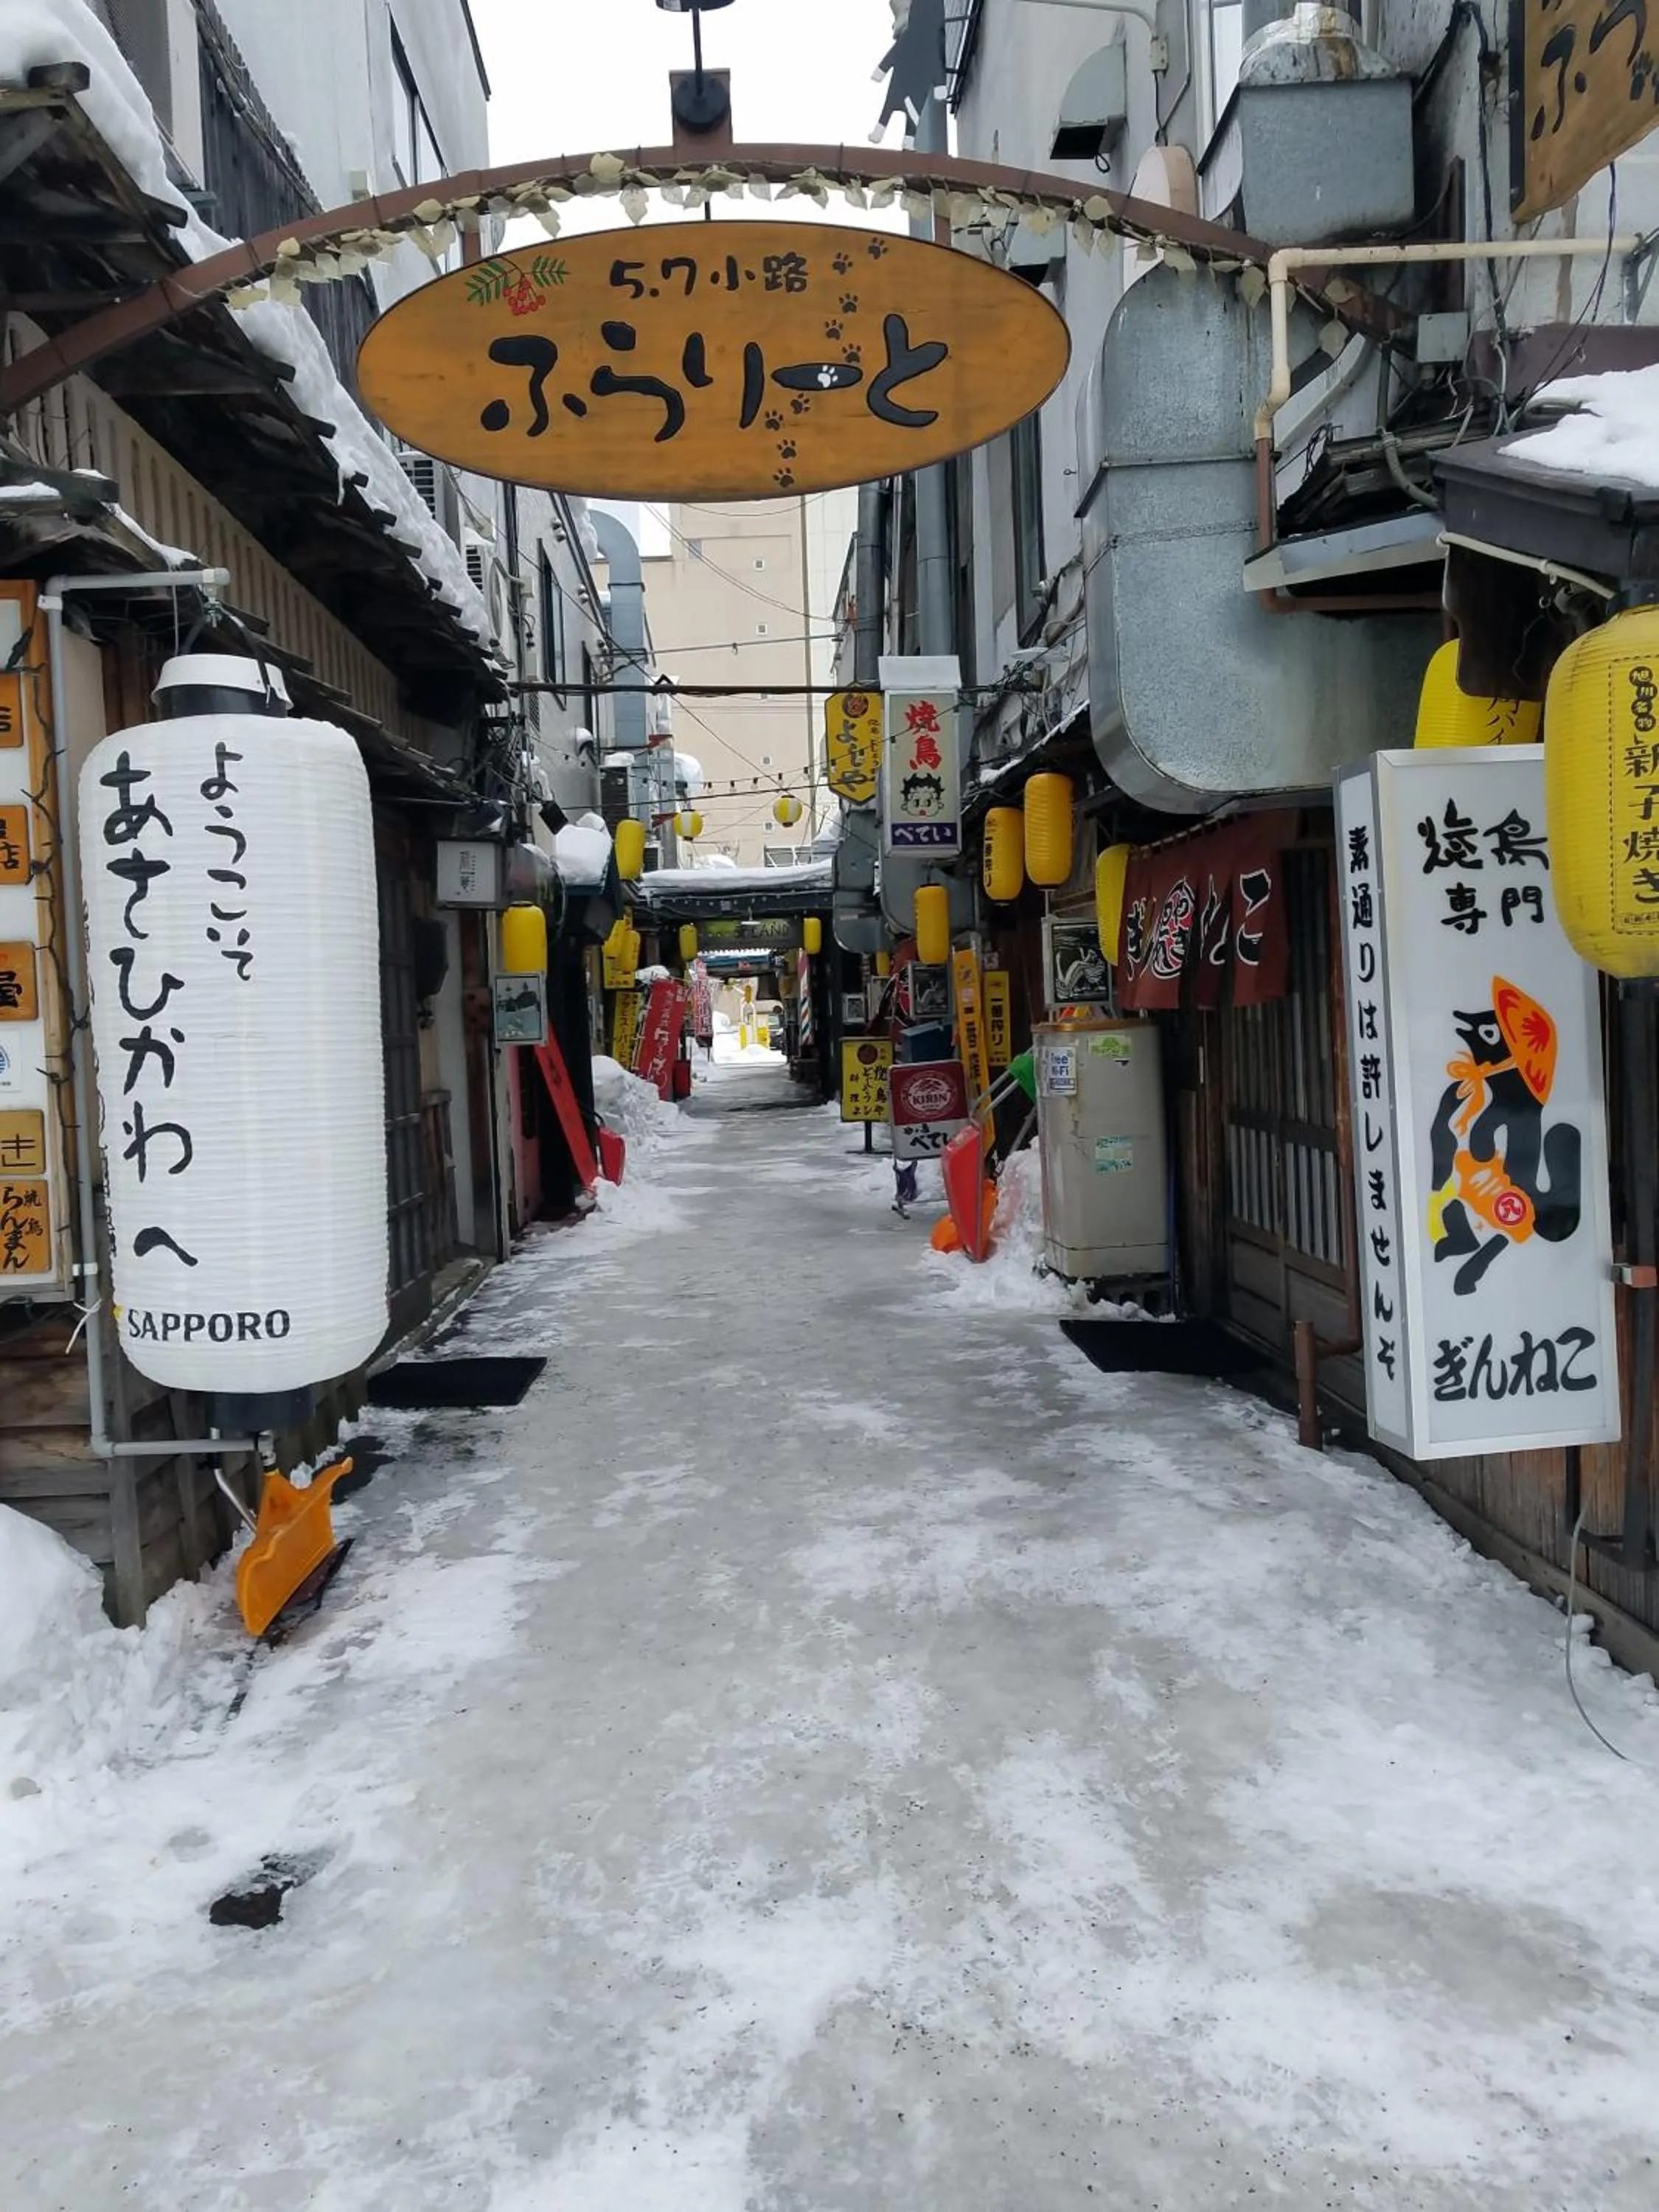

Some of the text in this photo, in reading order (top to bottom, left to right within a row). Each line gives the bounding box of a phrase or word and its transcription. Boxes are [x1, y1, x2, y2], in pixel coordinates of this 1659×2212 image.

[610, 252, 810, 299] 5.7小路
[480, 313, 949, 443] ふらりーと
[905, 700, 942, 771] 焼鳥
[200, 741, 254, 981] ようこそ
[1417, 798, 1549, 874] 焼鳥
[1441, 883, 1545, 935] 専門
[100, 751, 199, 1267] あさひかわへ
[912, 1093, 947, 1105] KIRIN
[128, 1309, 291, 1343] SAPPORO
[1433, 1326, 1597, 1402] ぎんねこ
